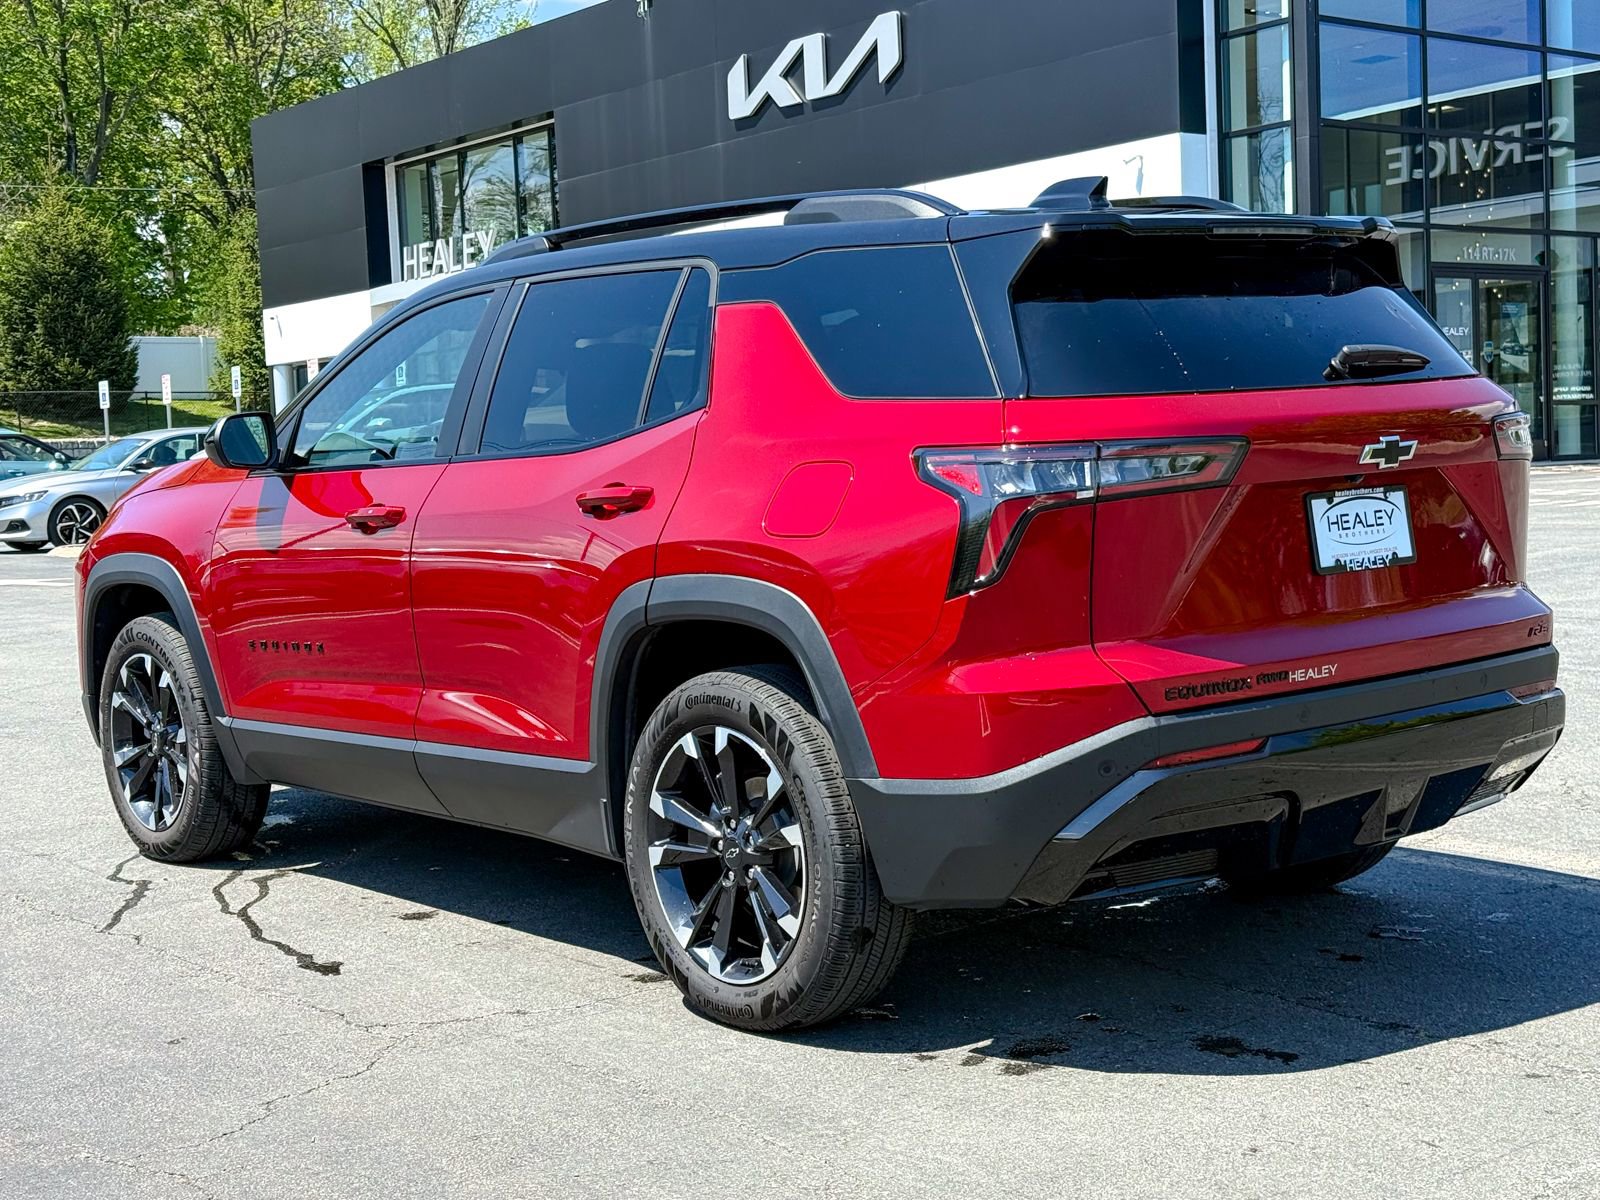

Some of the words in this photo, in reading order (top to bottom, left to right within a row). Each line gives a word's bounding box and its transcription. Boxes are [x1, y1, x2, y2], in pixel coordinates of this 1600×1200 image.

[727, 10, 903, 121] KIA
[403, 228, 496, 282] HEALEY
[1463, 246, 1481, 261] 114
[1335, 487, 1384, 497] healeybrothers.com
[1327, 508, 1394, 532] HEALEY
[1338, 528, 1387, 539] BROTHERS
[1346, 555, 1390, 571] HEALEY
[247, 639, 325, 655] EQUINOX
[1164, 677, 1253, 701] EQUINOX
[1288, 663, 1338, 683] HEALEY
[684, 691, 736, 710] Continental
